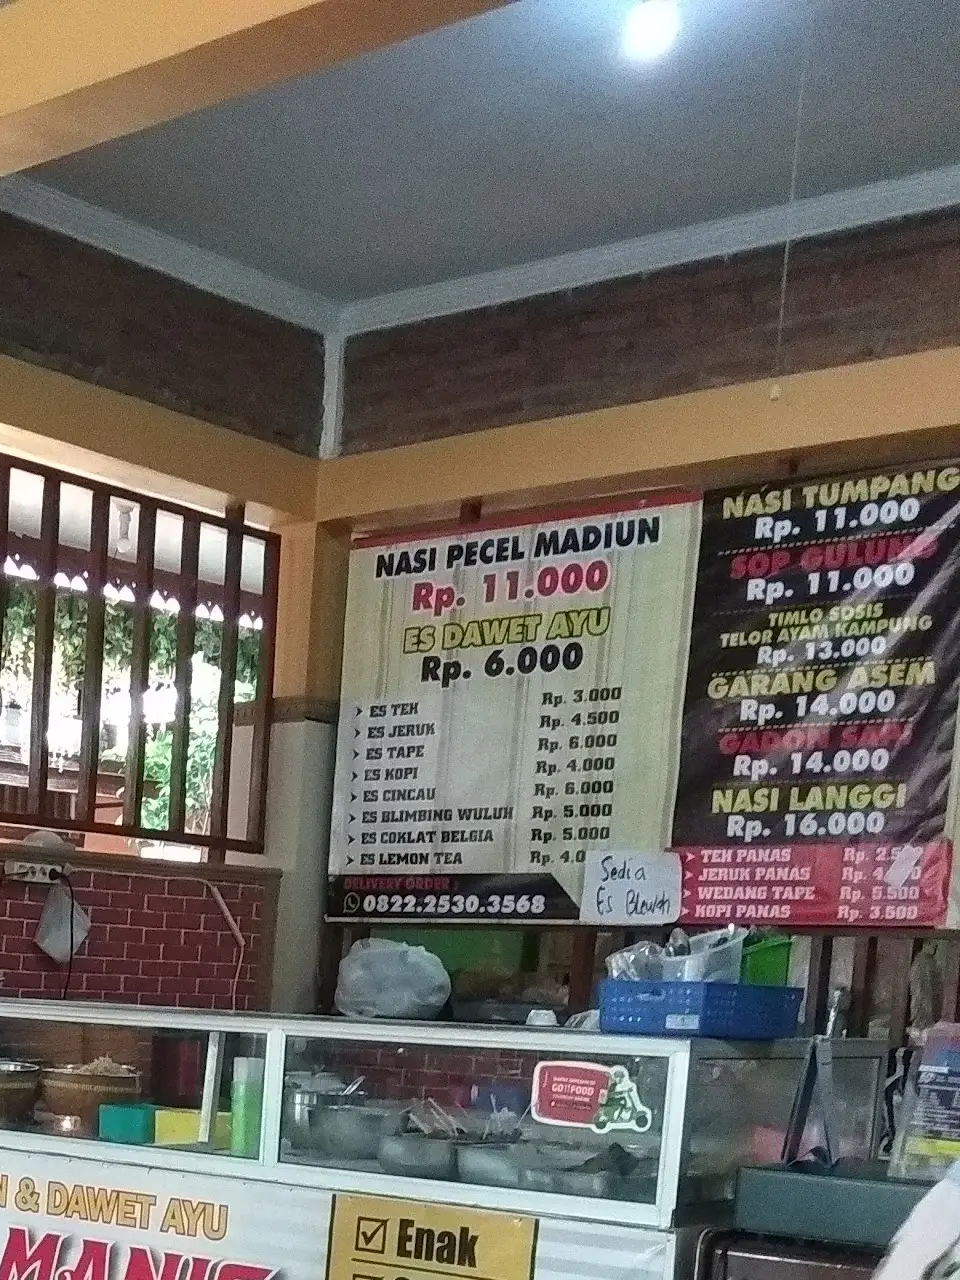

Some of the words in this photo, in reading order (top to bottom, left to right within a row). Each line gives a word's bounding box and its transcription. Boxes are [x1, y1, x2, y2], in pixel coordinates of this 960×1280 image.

[723, 488, 791, 519] NASI
[802, 467, 960, 509] TUMPANG
[754, 516, 800, 543] Rp.
[815, 498, 920, 532] 11.000
[375, 549, 436, 578] NASI
[447, 537, 525, 569] PECEL
[534, 517, 660, 558] MADIUN
[730, 550, 790, 578] SOP
[412, 581, 466, 615] Rp.
[483, 560, 609, 602] 11.000
[747, 578, 794, 605] Rp.
[808, 562, 915, 595] 11.000
[769, 608, 823, 627] TIMLO
[829, 603, 883, 620] SOSIS
[403, 626, 435, 654] ES
[442, 614, 541, 650] DAWET
[547, 606, 611, 639] AYU
[720, 629, 773, 647] TELOR
[777, 623, 829, 643] AYAM
[835, 615, 932, 638] KAMPUNG
[757, 646, 794, 667] Rp.
[805, 636, 887, 660] 13.000
[421, 654, 471, 688] Rp.
[484, 642, 584, 676] 6.000
[708, 669, 837, 699] GARANG
[847, 661, 936, 689] ASEM
[541, 691, 566, 708] Rp.
[573, 687, 622, 704] 3.000
[740, 699, 783, 725] Rp.
[796, 689, 896, 717] 14.000
[369, 705, 388, 719] ES
[392, 703, 418, 717] TEH
[540, 715, 565, 731] Rp.
[570, 710, 620, 726] 4.500
[367, 726, 385, 740] ES
[388, 723, 435, 738] JERUK
[365, 747, 384, 760] ES
[387, 745, 424, 759] TAPE
[537, 737, 562, 754] Rp.
[569, 734, 618, 750] 6.000
[364, 768, 382, 782] ES
[385, 766, 418, 781] KOPI
[536, 761, 560, 777] Rp.
[566, 757, 615, 773] 4.000
[733, 755, 778, 781] Rp.
[791, 749, 889, 774] 14.000
[363, 789, 379, 802] ES
[382, 787, 436, 801] CINCAU
[533, 783, 558, 799] Rp.
[565, 780, 613, 796] 6.000
[712, 787, 780, 813] NASI
[789, 783, 906, 811] LANGGI
[361, 811, 377, 824] ES
[381, 808, 453, 823] BLIMBING
[457, 807, 513, 821] WULUH
[532, 806, 557, 822] Rp.
[562, 803, 612, 819] 5.000
[530, 829, 555, 845] Rp.
[562, 826, 610, 842] 5.000
[727, 815, 771, 842] Rp.
[784, 811, 884, 836] 16.000
[360, 832, 377, 845] ES
[379, 831, 436, 845] COKLAT
[441, 829, 493, 844] BELGIA
[360, 853, 376, 866] ES
[379, 852, 429, 866] LEMON
[434, 851, 462, 866] TEA
[530, 851, 554, 867] Rp.
[701, 849, 733, 863] TEH
[736, 848, 791, 862] PANAS
[843, 847, 868, 864] Rp.
[601, 855, 646, 882] Sedia
[698, 867, 751, 881] JERUK
[755, 865, 811, 881] PANAS
[842, 866, 867, 883] Rp.
[596, 885, 613, 915] Es
[698, 886, 768, 900] WEDANG
[772, 886, 816, 900] TAPE
[840, 886, 865, 903] Rp.
[363, 894, 546, 914] 0822.2530.3568
[694, 904, 732, 918] KOPI
[735, 904, 791, 918] PANAS
[837, 905, 862, 922] Rp.
[15, 1177, 40, 1213] &
[46, 1181, 157, 1230] DAWET
[160, 1198, 228, 1240] AYU
[396, 1219, 480, 1268] Enak
